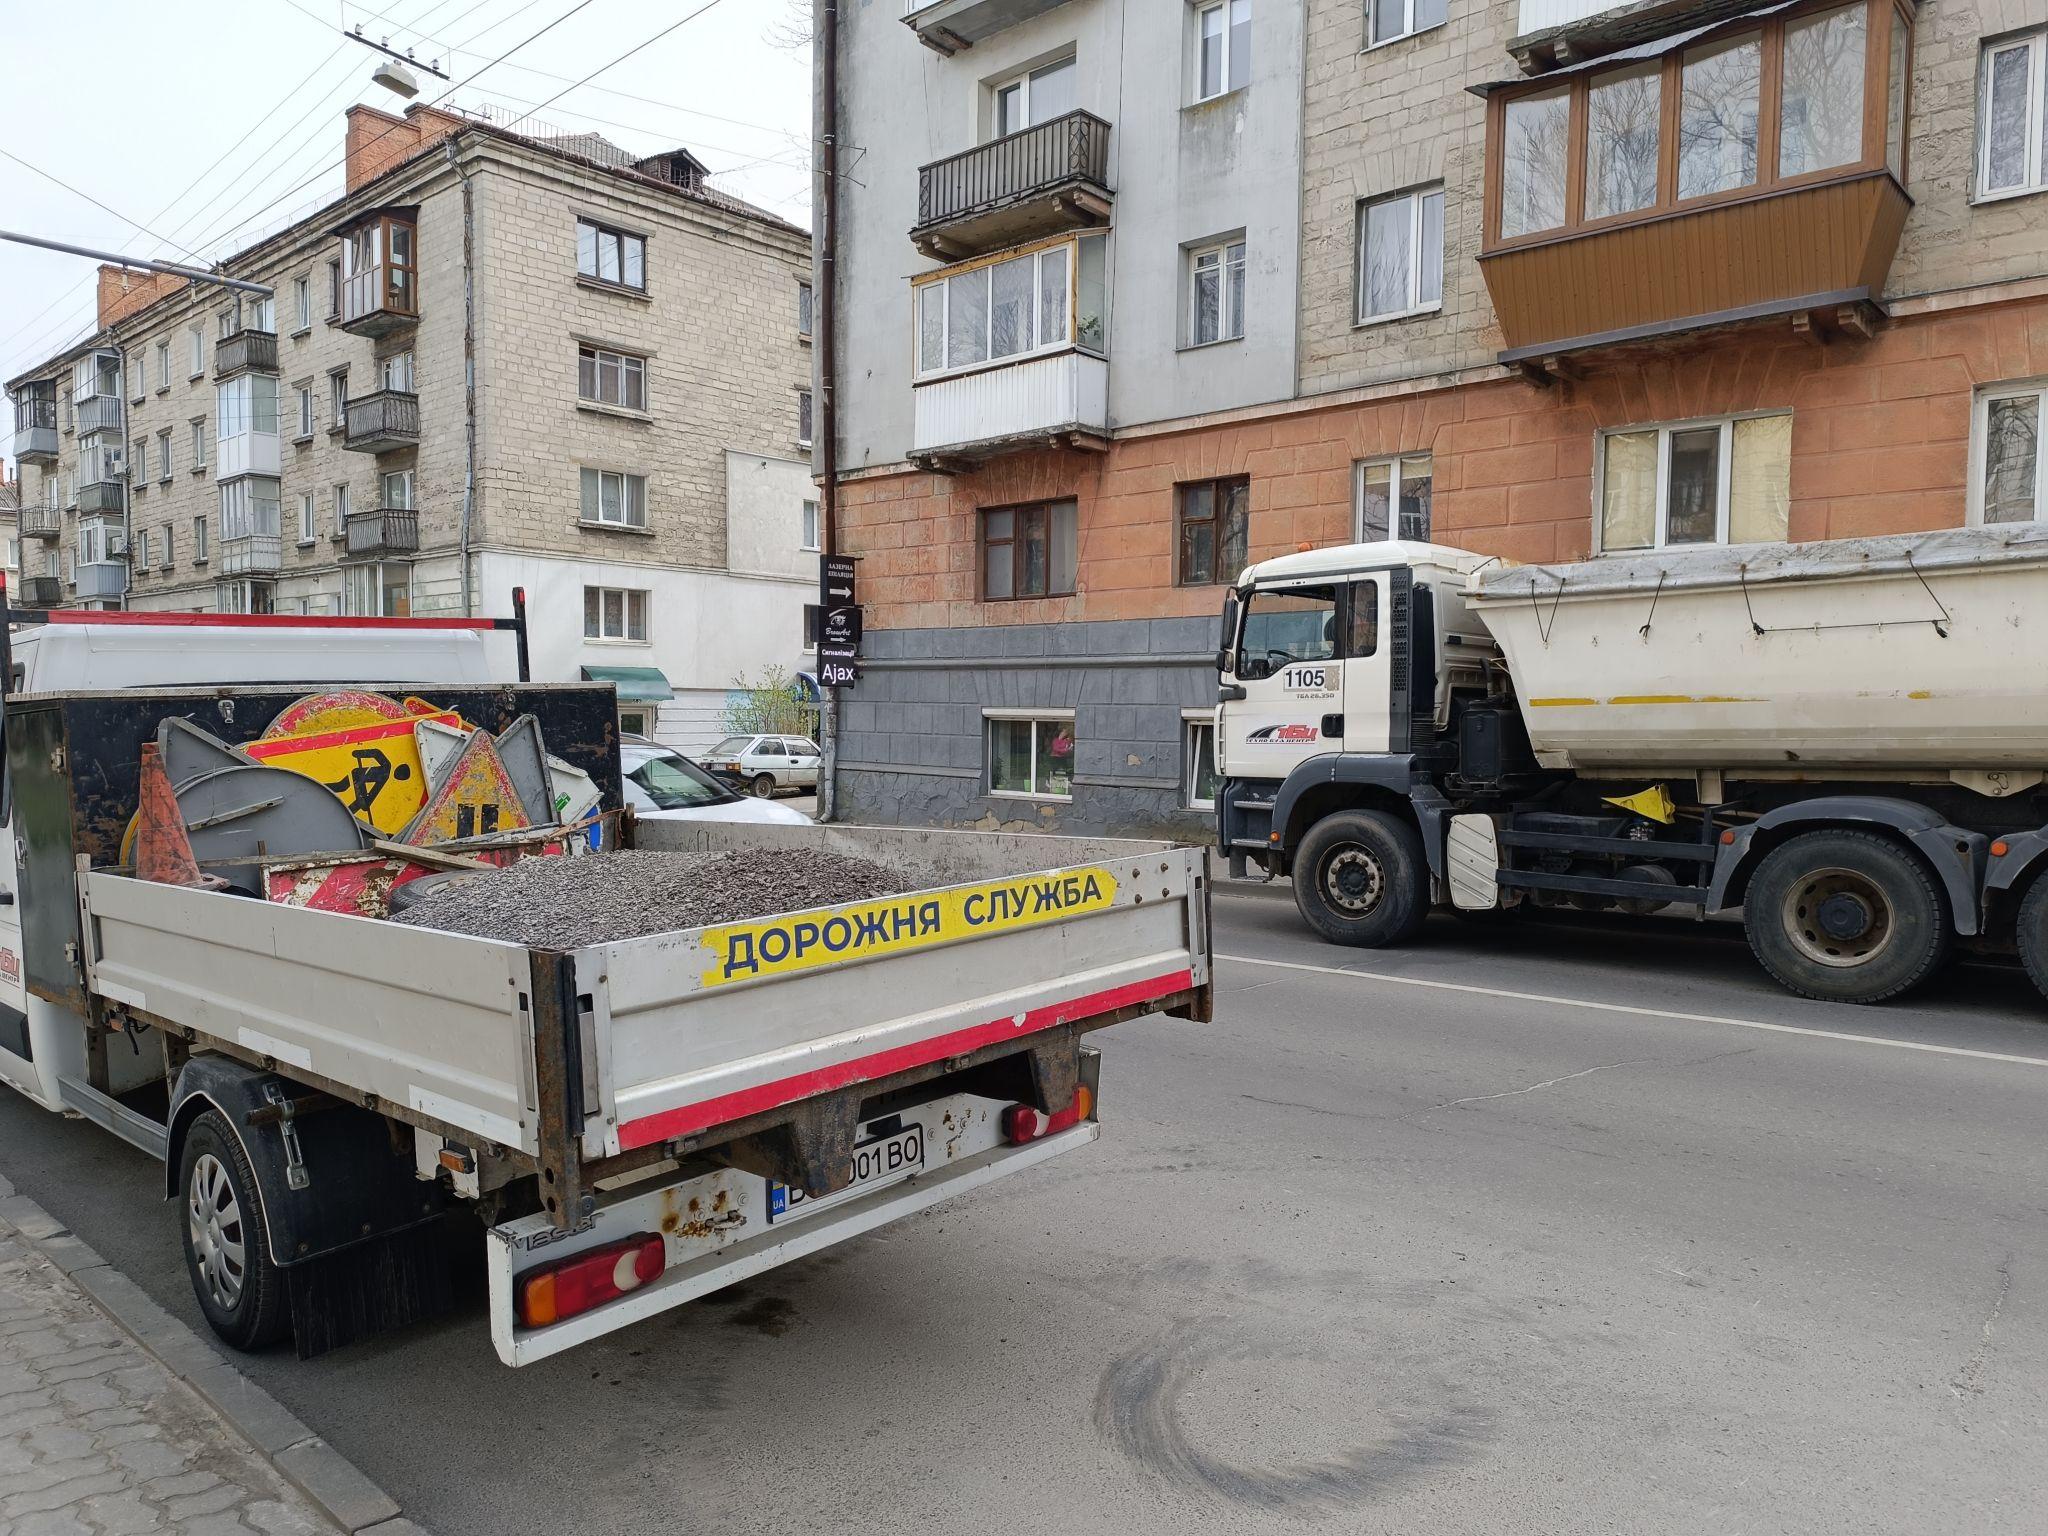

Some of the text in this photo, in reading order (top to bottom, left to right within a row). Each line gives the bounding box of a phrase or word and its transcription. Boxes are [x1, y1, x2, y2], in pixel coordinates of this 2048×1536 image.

[828, 563, 853, 571] ЛАЗЕРНА
[822, 663, 854, 684] Ajax
[1285, 669, 1325, 688] 1105
[724, 874, 1102, 979] ДОРОЖНЯ СЛУЖБА
[888, 1135, 918, 1170] BO
[773, 1198, 784, 1209] UA
